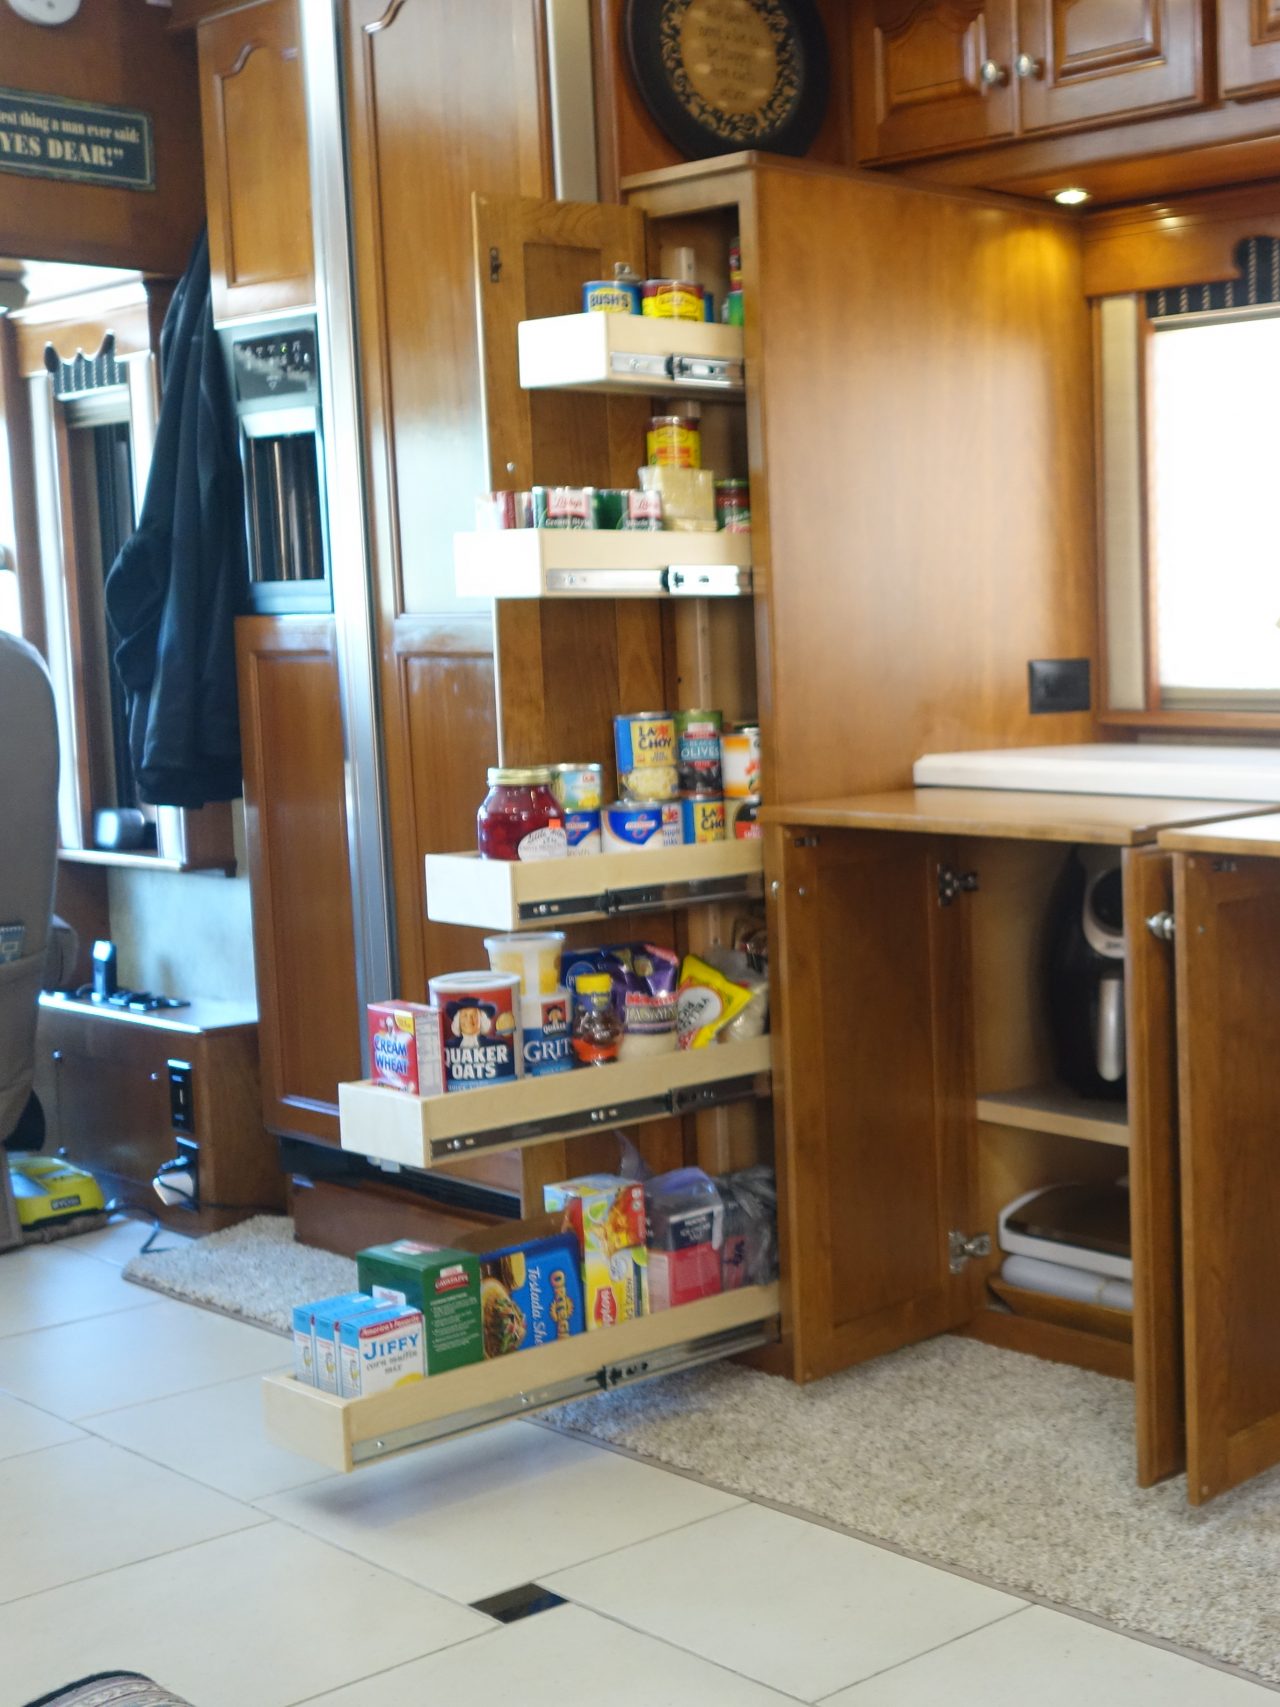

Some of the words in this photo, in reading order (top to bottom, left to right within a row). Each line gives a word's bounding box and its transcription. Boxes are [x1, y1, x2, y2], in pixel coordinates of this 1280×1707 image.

[20, 111, 49, 134] thing
[51, 119, 59, 131] a
[62, 120, 86, 135] man
[87, 125, 112, 139] ever
[681, 746, 719, 758] OLIVES
[374, 1036, 408, 1057] CREAM
[523, 1038, 573, 1063] GRIT
[376, 1052, 408, 1074] WHEAT
[452, 1063, 497, 1080] OATS
[363, 1333, 419, 1360] JIFFY
